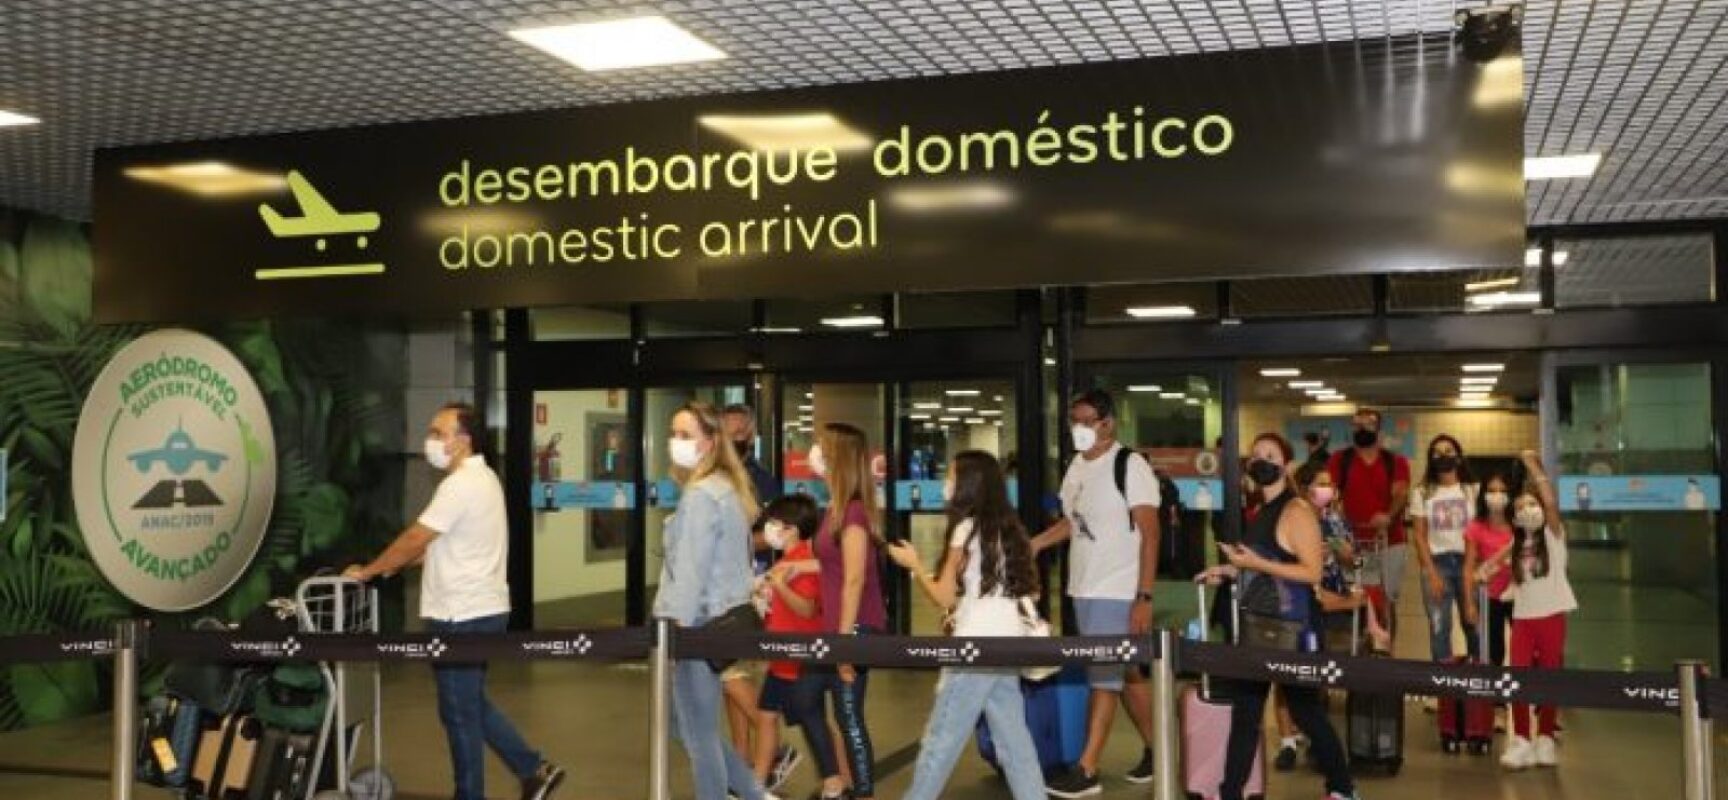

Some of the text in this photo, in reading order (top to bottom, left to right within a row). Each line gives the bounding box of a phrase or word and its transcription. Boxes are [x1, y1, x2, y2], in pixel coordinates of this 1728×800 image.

[438, 105, 1234, 206] desembarque doméstico
[438, 199, 877, 270] domestic arrival
[120, 351, 238, 406] AERÓDROMO
[120, 531, 231, 582] AVANÇADO
[759, 642, 808, 652] VINCI
[906, 647, 957, 658] VINCI
[1061, 647, 1113, 657] VINCI
[1265, 662, 1317, 676] VINCI
[1431, 675, 1491, 690] VINCI
[1623, 686, 1680, 700] VINC
